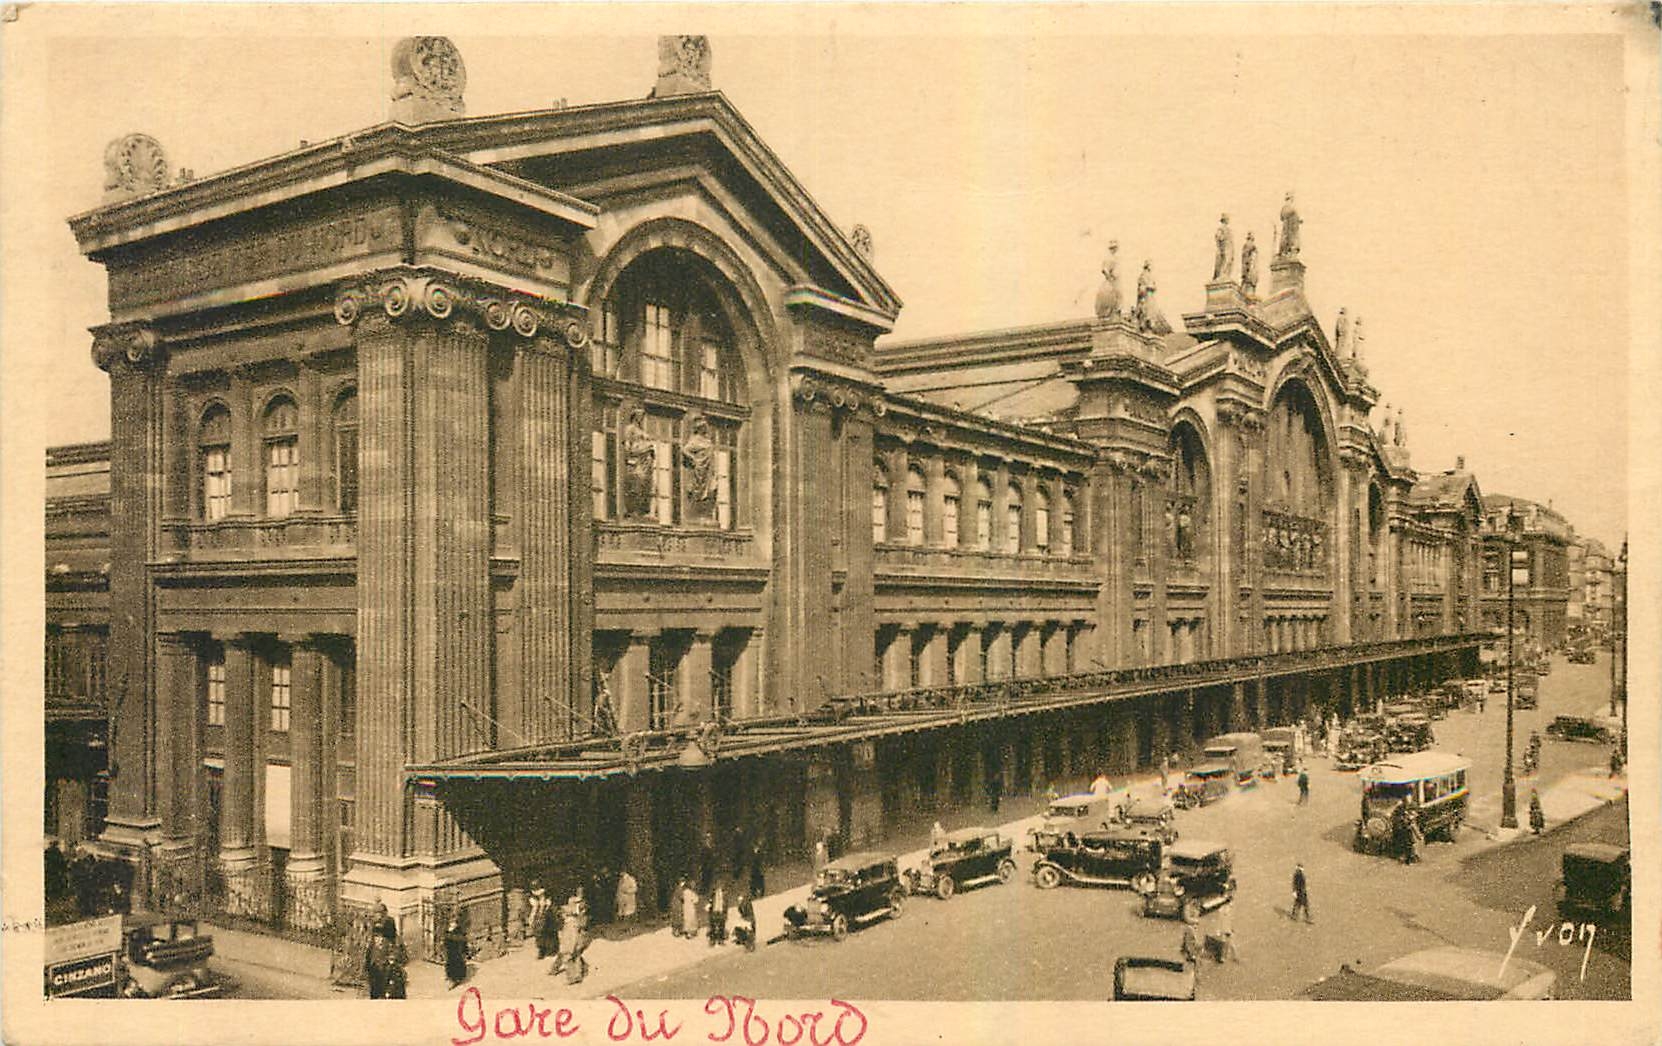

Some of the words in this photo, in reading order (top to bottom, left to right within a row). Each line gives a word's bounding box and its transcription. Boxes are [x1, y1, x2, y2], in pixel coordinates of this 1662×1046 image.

[54, 963, 111, 986] CINZANO
[452, 986, 580, 1046] Gare
[606, 994, 682, 1041] du
[703, 994, 868, 1046] Nord
